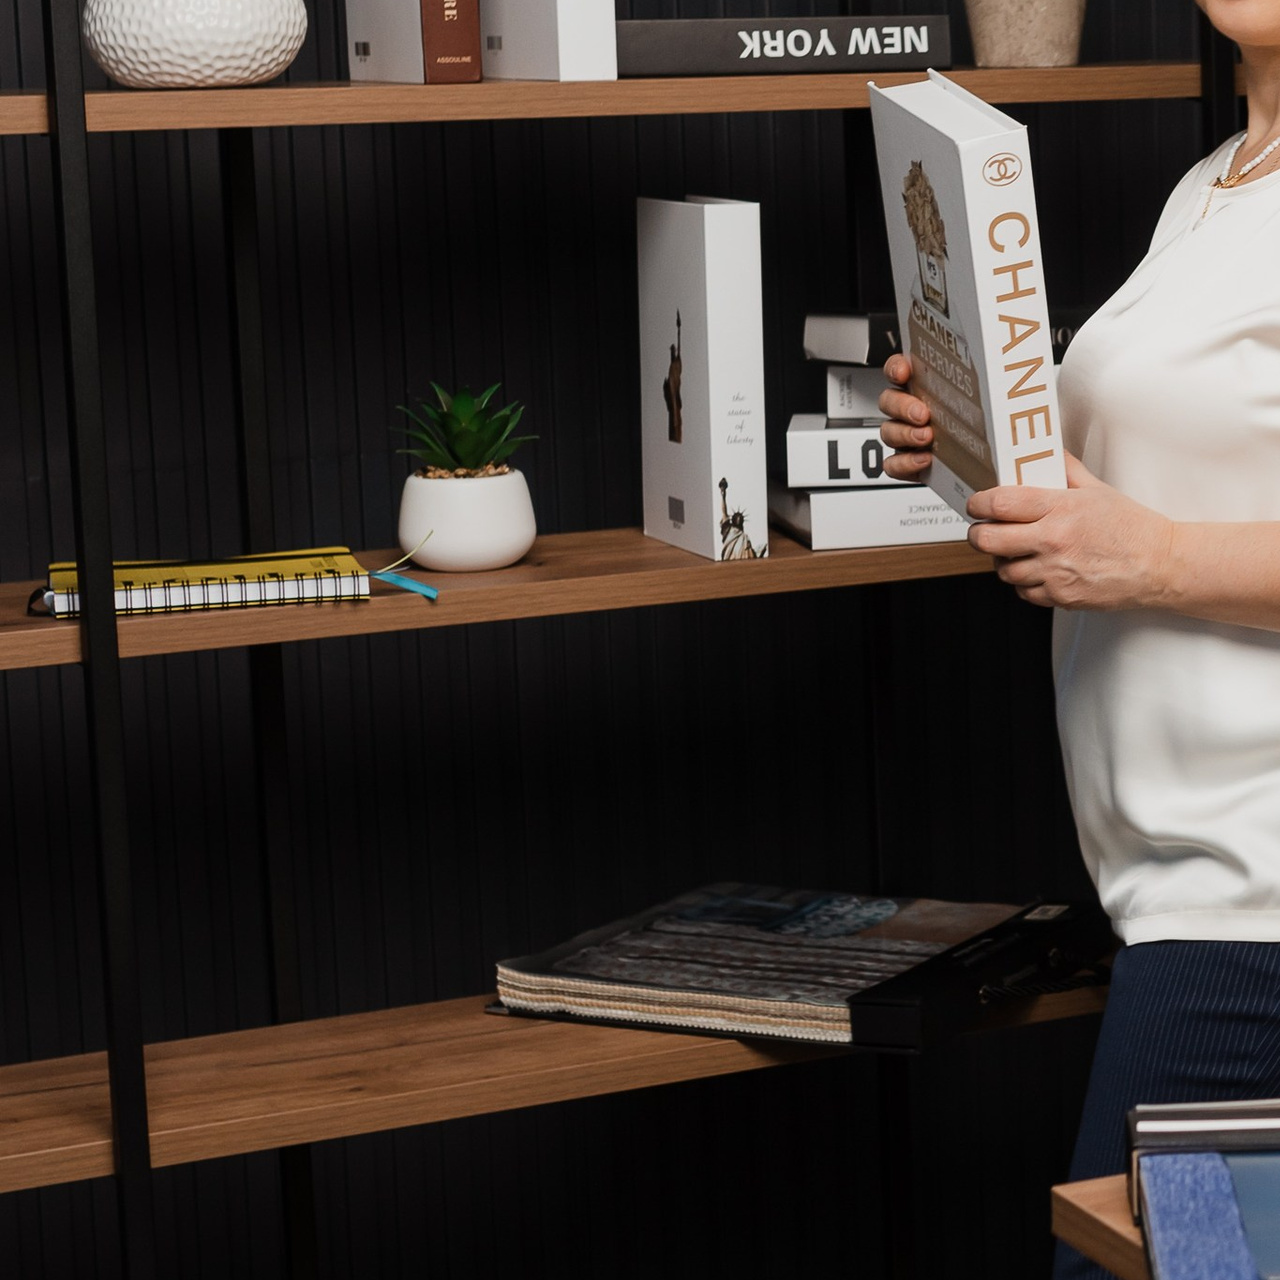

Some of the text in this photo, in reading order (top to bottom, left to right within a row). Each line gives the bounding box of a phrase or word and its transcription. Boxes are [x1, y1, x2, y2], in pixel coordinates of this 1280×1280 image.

[436, 55, 472, 64] ASSOULINE
[737, 25, 930, 59] NEW YORK
[912, 299, 962, 361] CHANEL
[988, 211, 1055, 486] CHANEL
[827, 439, 884, 480] LO
[899, 517, 939, 527] FASHION
